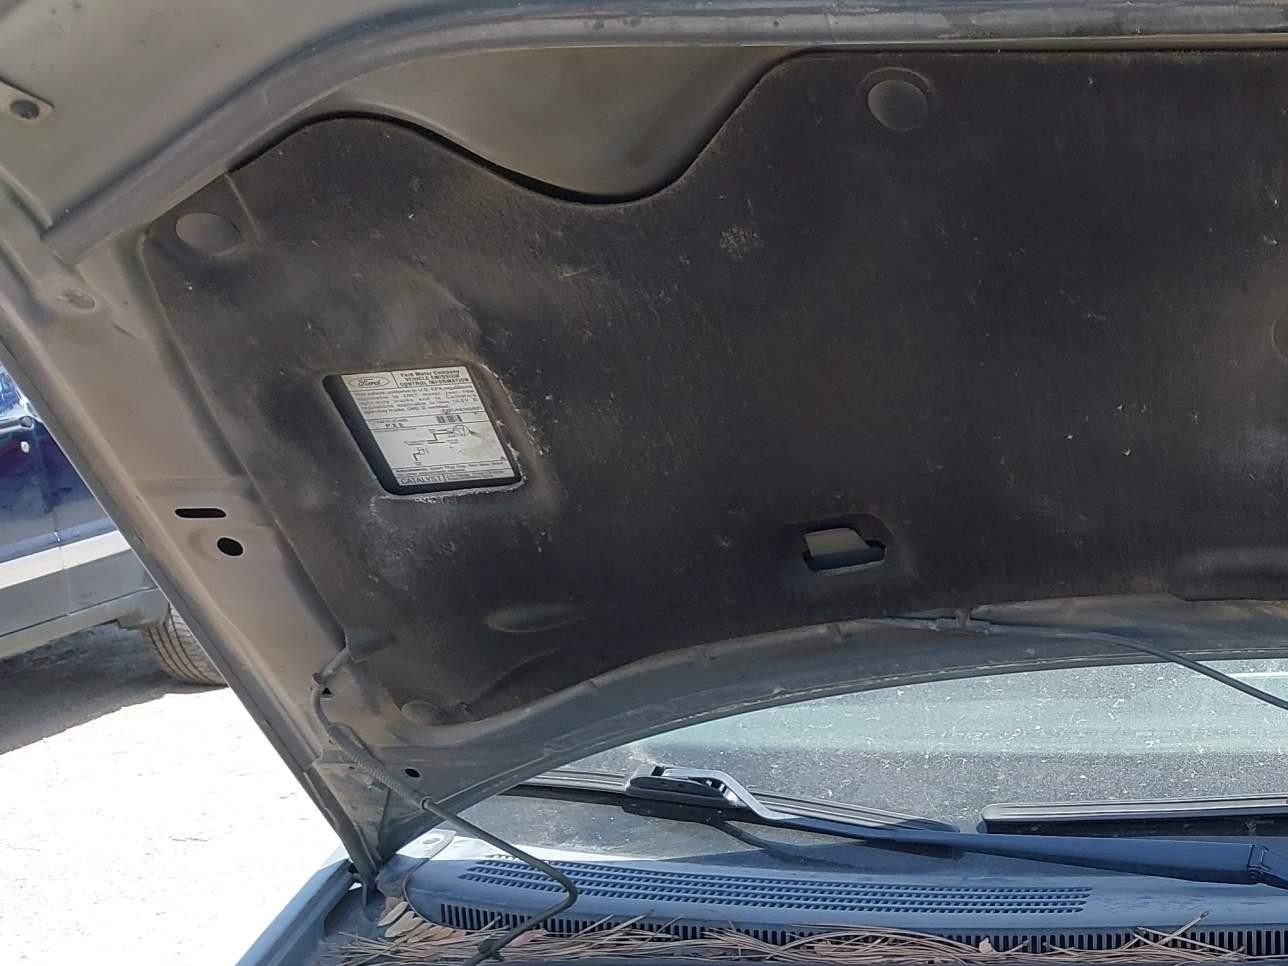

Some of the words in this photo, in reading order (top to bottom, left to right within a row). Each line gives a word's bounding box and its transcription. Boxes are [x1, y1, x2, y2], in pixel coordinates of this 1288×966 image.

[433, 368, 460, 376] Company
[358, 377, 381, 386] Ford
[400, 475, 442, 484] CATALYST
